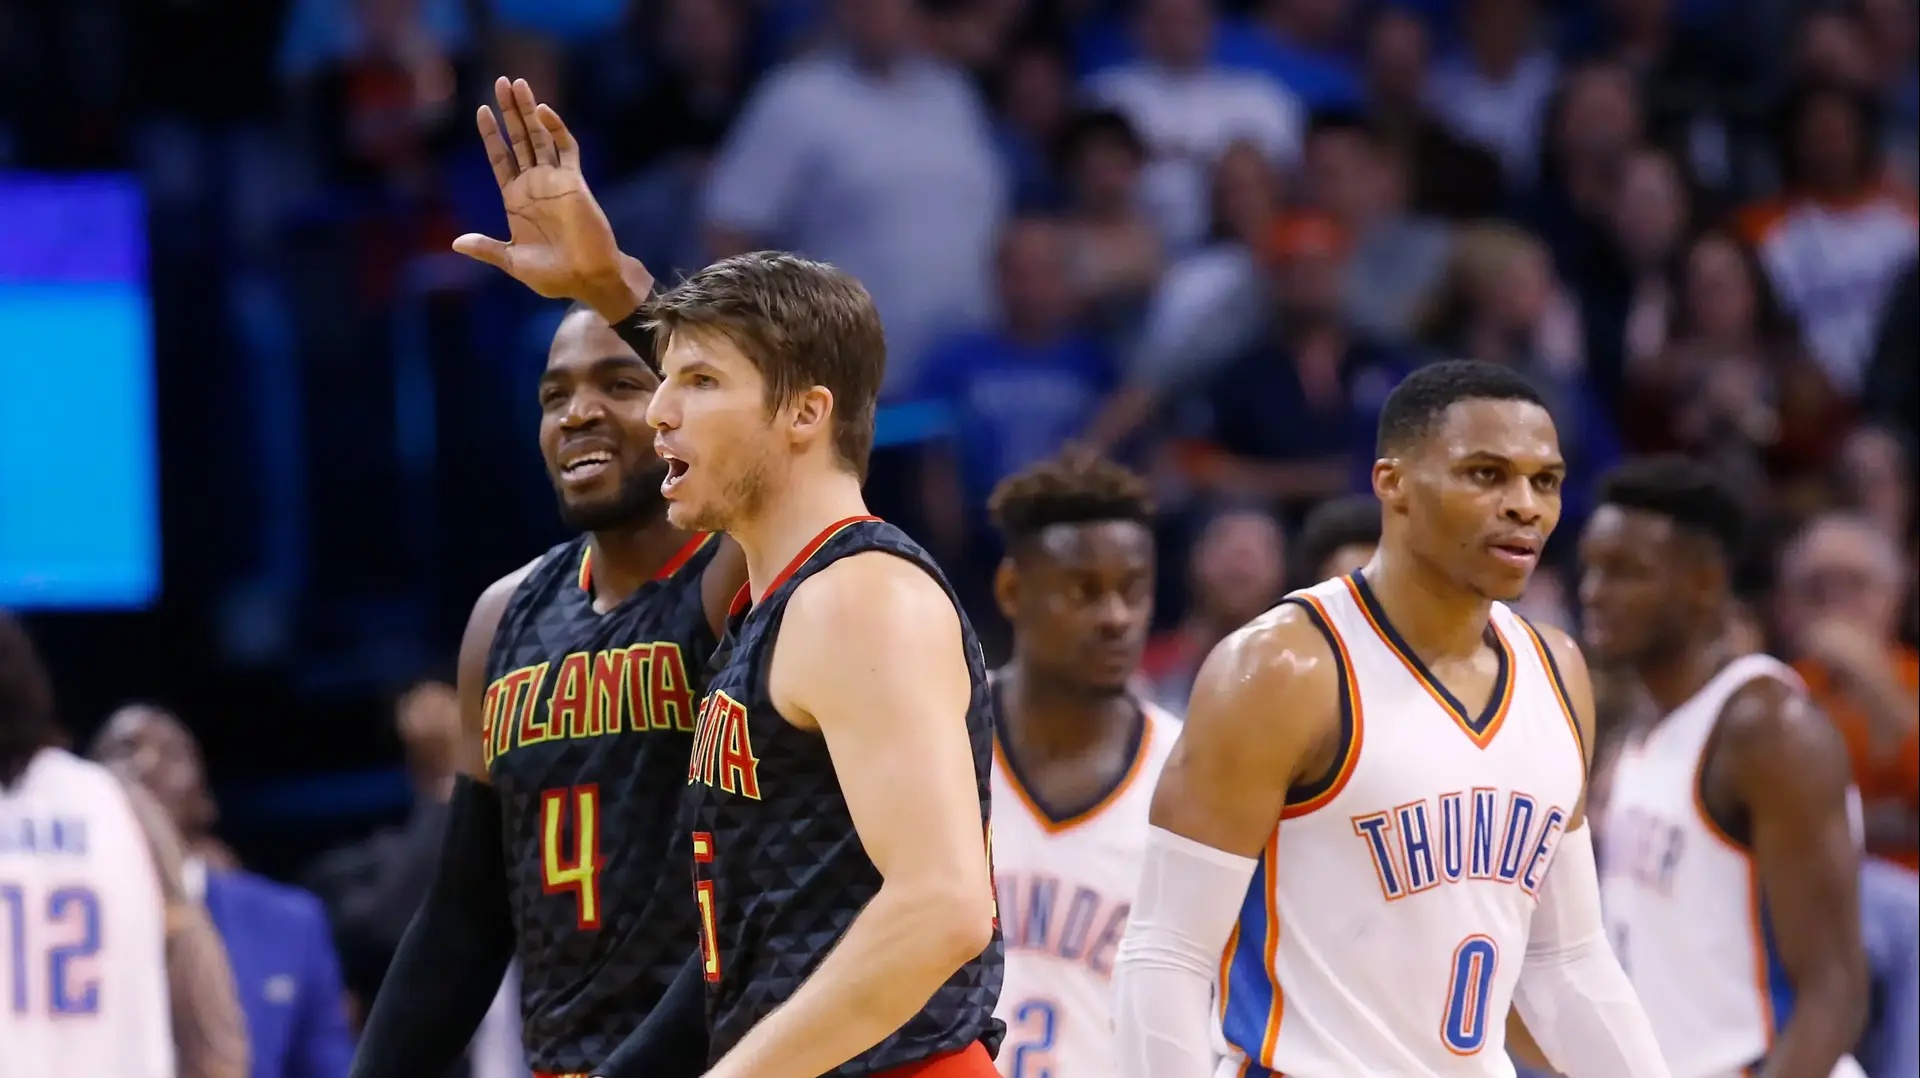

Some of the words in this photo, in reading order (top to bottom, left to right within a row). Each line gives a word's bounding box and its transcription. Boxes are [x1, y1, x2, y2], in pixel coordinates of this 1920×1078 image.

[482, 640, 696, 773] ATLANTA
[539, 783, 607, 930] 4
[1351, 786, 1566, 904] THUNDE
[0, 882, 103, 1018] 12
[1440, 933, 1500, 1057] 0
